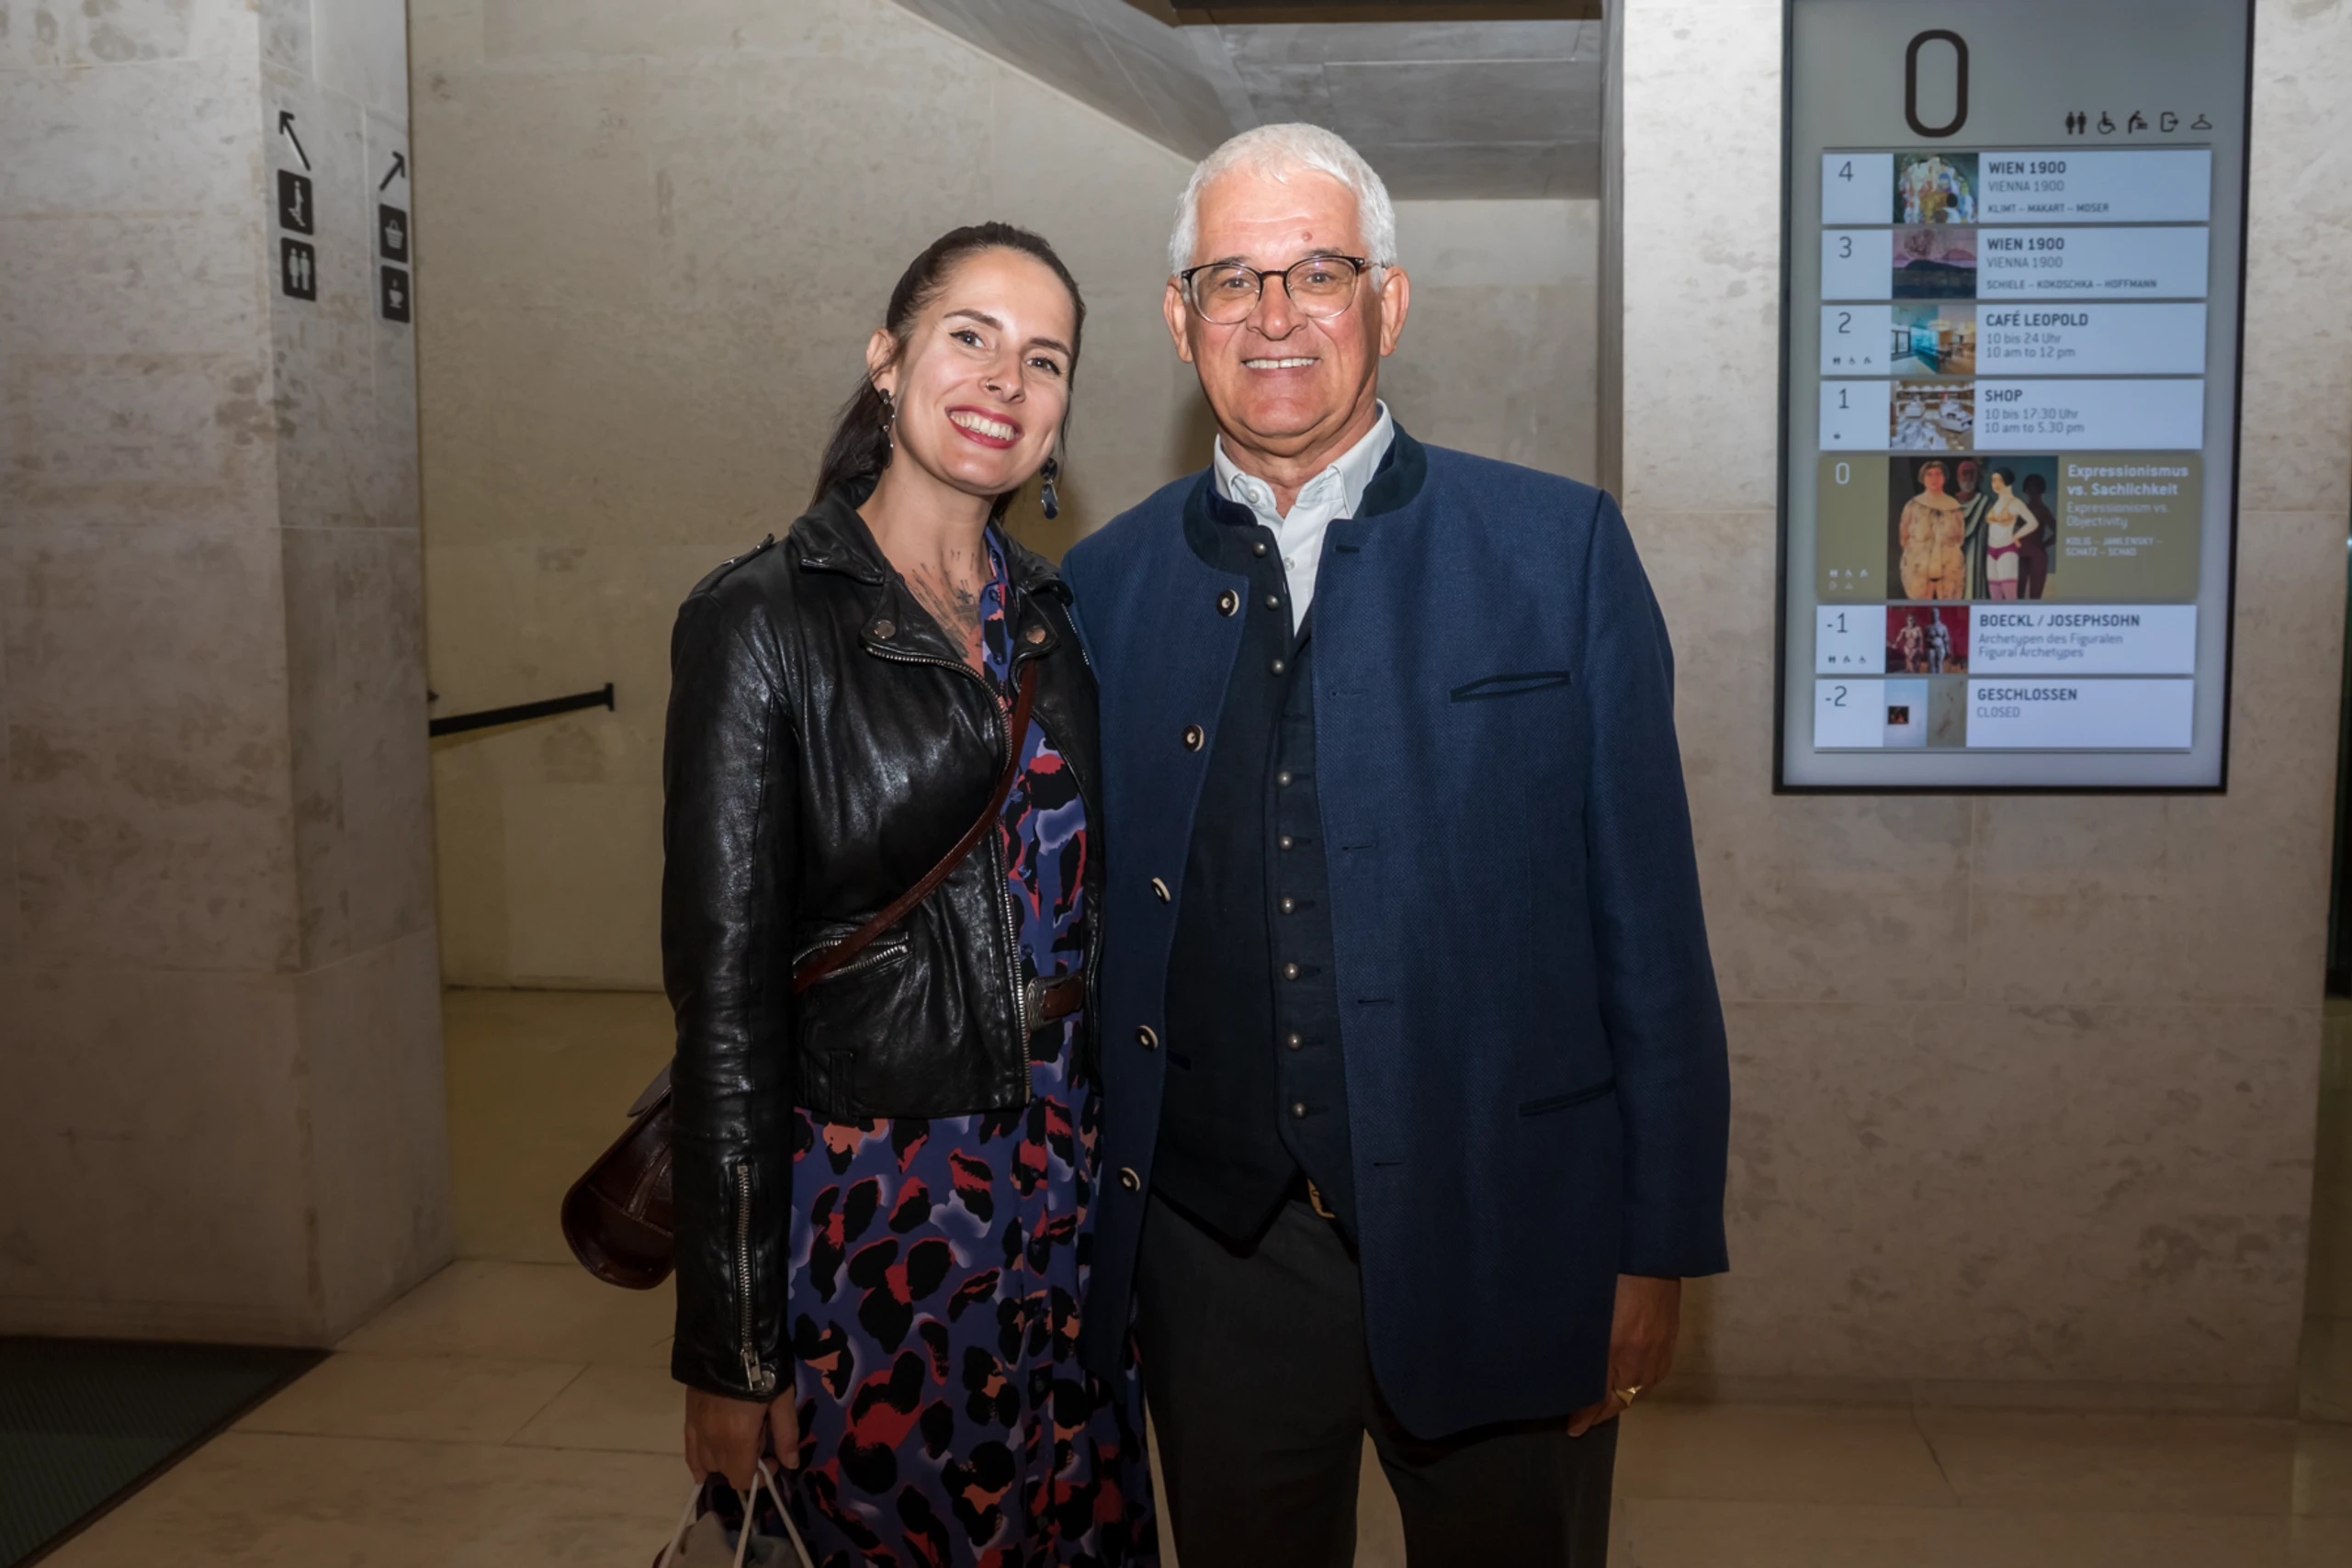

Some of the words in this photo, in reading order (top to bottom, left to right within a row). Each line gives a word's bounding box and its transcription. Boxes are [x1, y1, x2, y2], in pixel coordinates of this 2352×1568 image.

[1905, 29, 1969, 138] 0
[1838, 161, 1854, 183] 4
[1988, 162, 2025, 175] WIEN
[2030, 161, 2066, 174] 1900
[1987, 181, 2030, 192] VIENNA
[2033, 180, 2065, 192] 1900
[1987, 204, 2017, 213] KLIMT
[2028, 203, 2065, 212] MAKART
[2076, 203, 2109, 212] MOSER
[1838, 236, 1852, 258] 3
[1987, 238, 2023, 251] WIEN
[2028, 237, 2065, 250] 1900
[1986, 257, 2030, 268] VIENNA
[2032, 256, 2064, 268] 1900
[1986, 280, 2025, 289] SCHIELE
[2037, 279, 2094, 289] KOKOSCHKA
[2104, 279, 2157, 288] HOFFMANN
[1838, 311, 1852, 334] 2
[1985, 310, 2020, 326] CAFÉ
[2024, 313, 2088, 326] LEOPOLD
[1986, 333, 2001, 344] 10
[2004, 333, 2021, 344] bis
[2023, 333, 2039, 344] 24
[2041, 333, 2062, 344] Uhr
[1986, 346, 2001, 358] 10
[2004, 349, 2021, 358] am
[2024, 347, 2036, 358] to
[2040, 346, 2054, 358] 12
[2057, 348, 2075, 360] pm
[1838, 388, 1849, 410] 1
[1984, 389, 2023, 402] SHOP
[1985, 409, 2000, 420] 10
[2002, 409, 2019, 420] bis
[2059, 408, 2079, 419] Uhr
[1984, 422, 1999, 434] 10
[2002, 423, 2020, 433] am
[2023, 423, 2034, 433] to
[2066, 423, 2085, 435] pm
[1836, 462, 1850, 485] 0
[2067, 464, 2189, 481] Expressionismus
[2066, 485, 2087, 495] vs.
[2091, 482, 2178, 496] Sachlichkeit
[2066, 501, 2151, 516] Expressionism
[2066, 514, 2128, 530] Objectivity
[1826, 612, 1849, 634] -1
[1979, 615, 2034, 627] BOECKL
[2047, 614, 2141, 626] JOSEPHSOHN
[1979, 633, 2044, 647] Archetypen
[2046, 634, 2066, 644] des
[2070, 633, 2123, 647] Figuralen
[1978, 647, 2017, 660] Figural
[2019, 647, 2084, 660] Archetypes
[1825, 685, 1848, 707] -2
[1977, 688, 2078, 701] GESCHLOSSEN
[1976, 706, 2020, 718] CLOSED
